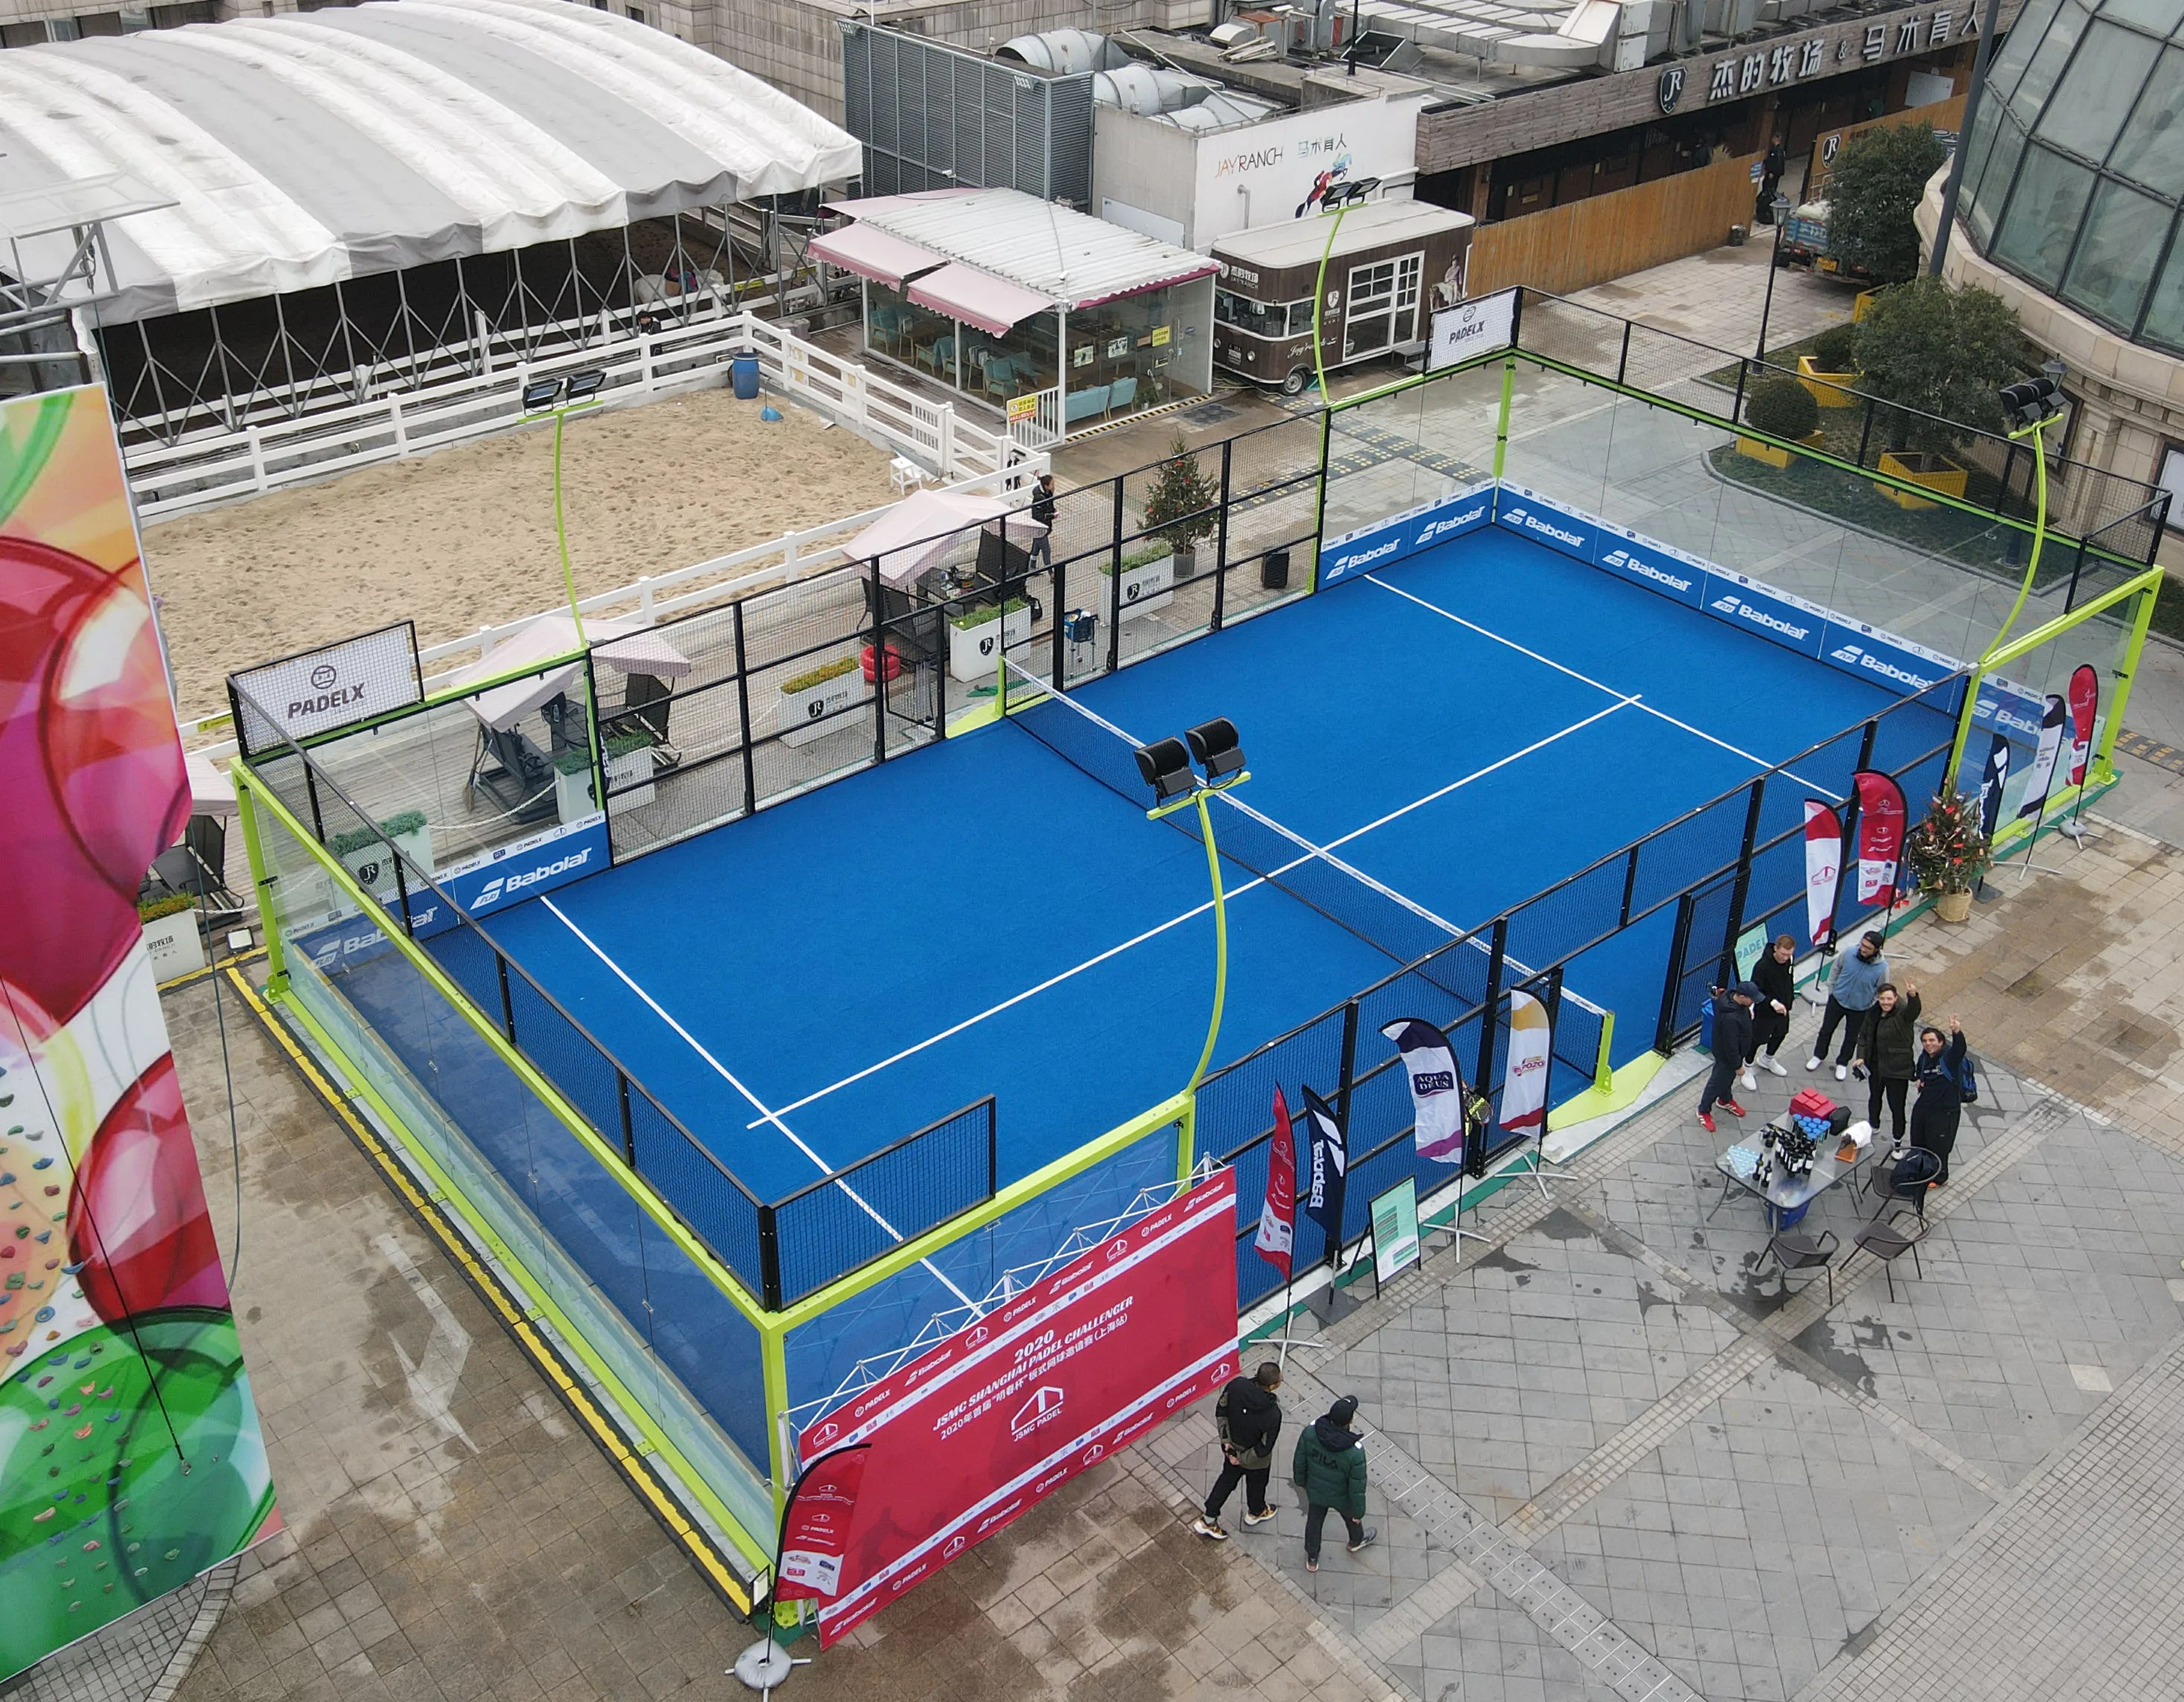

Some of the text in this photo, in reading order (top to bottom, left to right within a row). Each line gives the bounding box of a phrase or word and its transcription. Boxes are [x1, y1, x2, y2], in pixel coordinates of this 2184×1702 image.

[1709, 0, 1980, 100] 杰的牧场 & 马术育人
[1449, 321, 1486, 344] PADELX
[287, 682, 365, 719] PADELX
[1417, 1073, 1450, 1084] AQUA
[1150, 1213, 1173, 1232] PADELX
[1012, 1296, 1037, 1317] PADELX
[1014, 1329, 1054, 1364] 2020
[933, 1402, 967, 1431] JSMC
[969, 1361, 1027, 1408] SHANGHAI
[1028, 1339, 1063, 1369] PADEL
[1064, 1295, 1134, 1343] CHALLENGER
[865, 1389, 891, 1412] PADELX
[1014, 1407, 1062, 1442] JSMC PADEL
